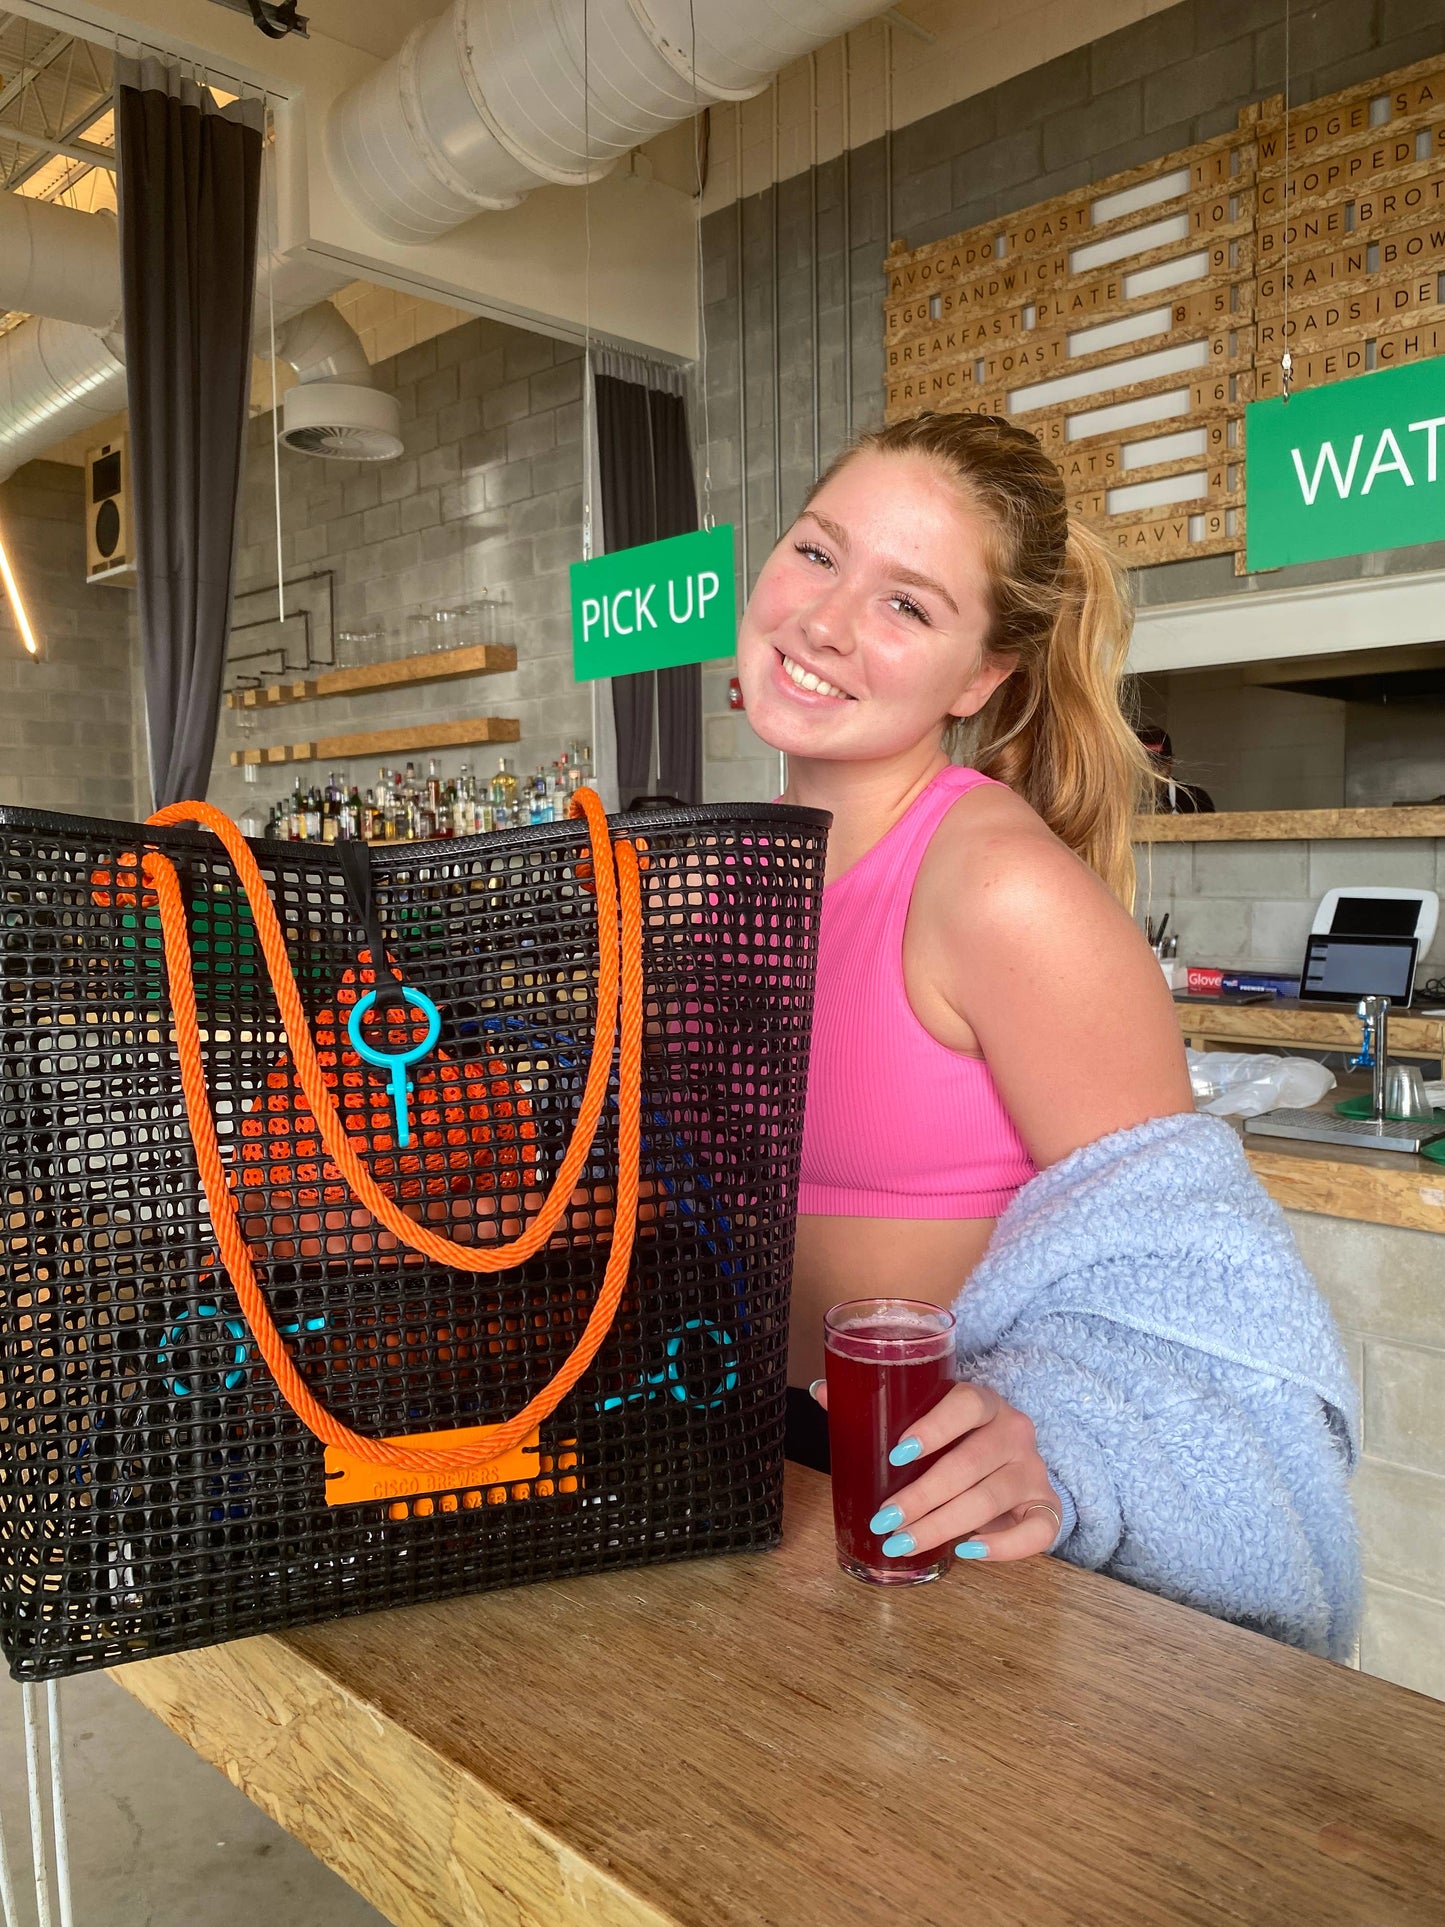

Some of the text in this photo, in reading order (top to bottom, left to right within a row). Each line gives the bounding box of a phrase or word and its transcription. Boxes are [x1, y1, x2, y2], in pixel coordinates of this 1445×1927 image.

[1262, 86, 1434, 158] WEDGE SA
[1262, 143, 1409, 204] CHOPPED
[891, 159, 1223, 291] AVOCADO TOAST 11
[1262, 180, 1444, 251] BONE BROT
[889, 205, 1224, 329] EGG SANDWICH 10
[1262, 230, 1445, 297] GRAIN BOW
[889, 251, 1224, 366] BREAKFAST PLATE 9
[1262, 282, 1431, 344] ROADSIDE
[890, 295, 1224, 403] FRENCH TOAST 8.5
[1213, 340, 1224, 356] 6
[1381, 331, 1436, 361] CHI
[1196, 384, 1225, 403] 16
[1212, 429, 1222, 444] 9
[1291, 416, 1445, 506] WAT
[1212, 473, 1222, 488] 4
[1210, 517, 1220, 532] 9
[581, 571, 720, 643] PICK UP
[373, 1476, 419, 1498] CISCO
[426, 1465, 500, 1492] BREWERS
